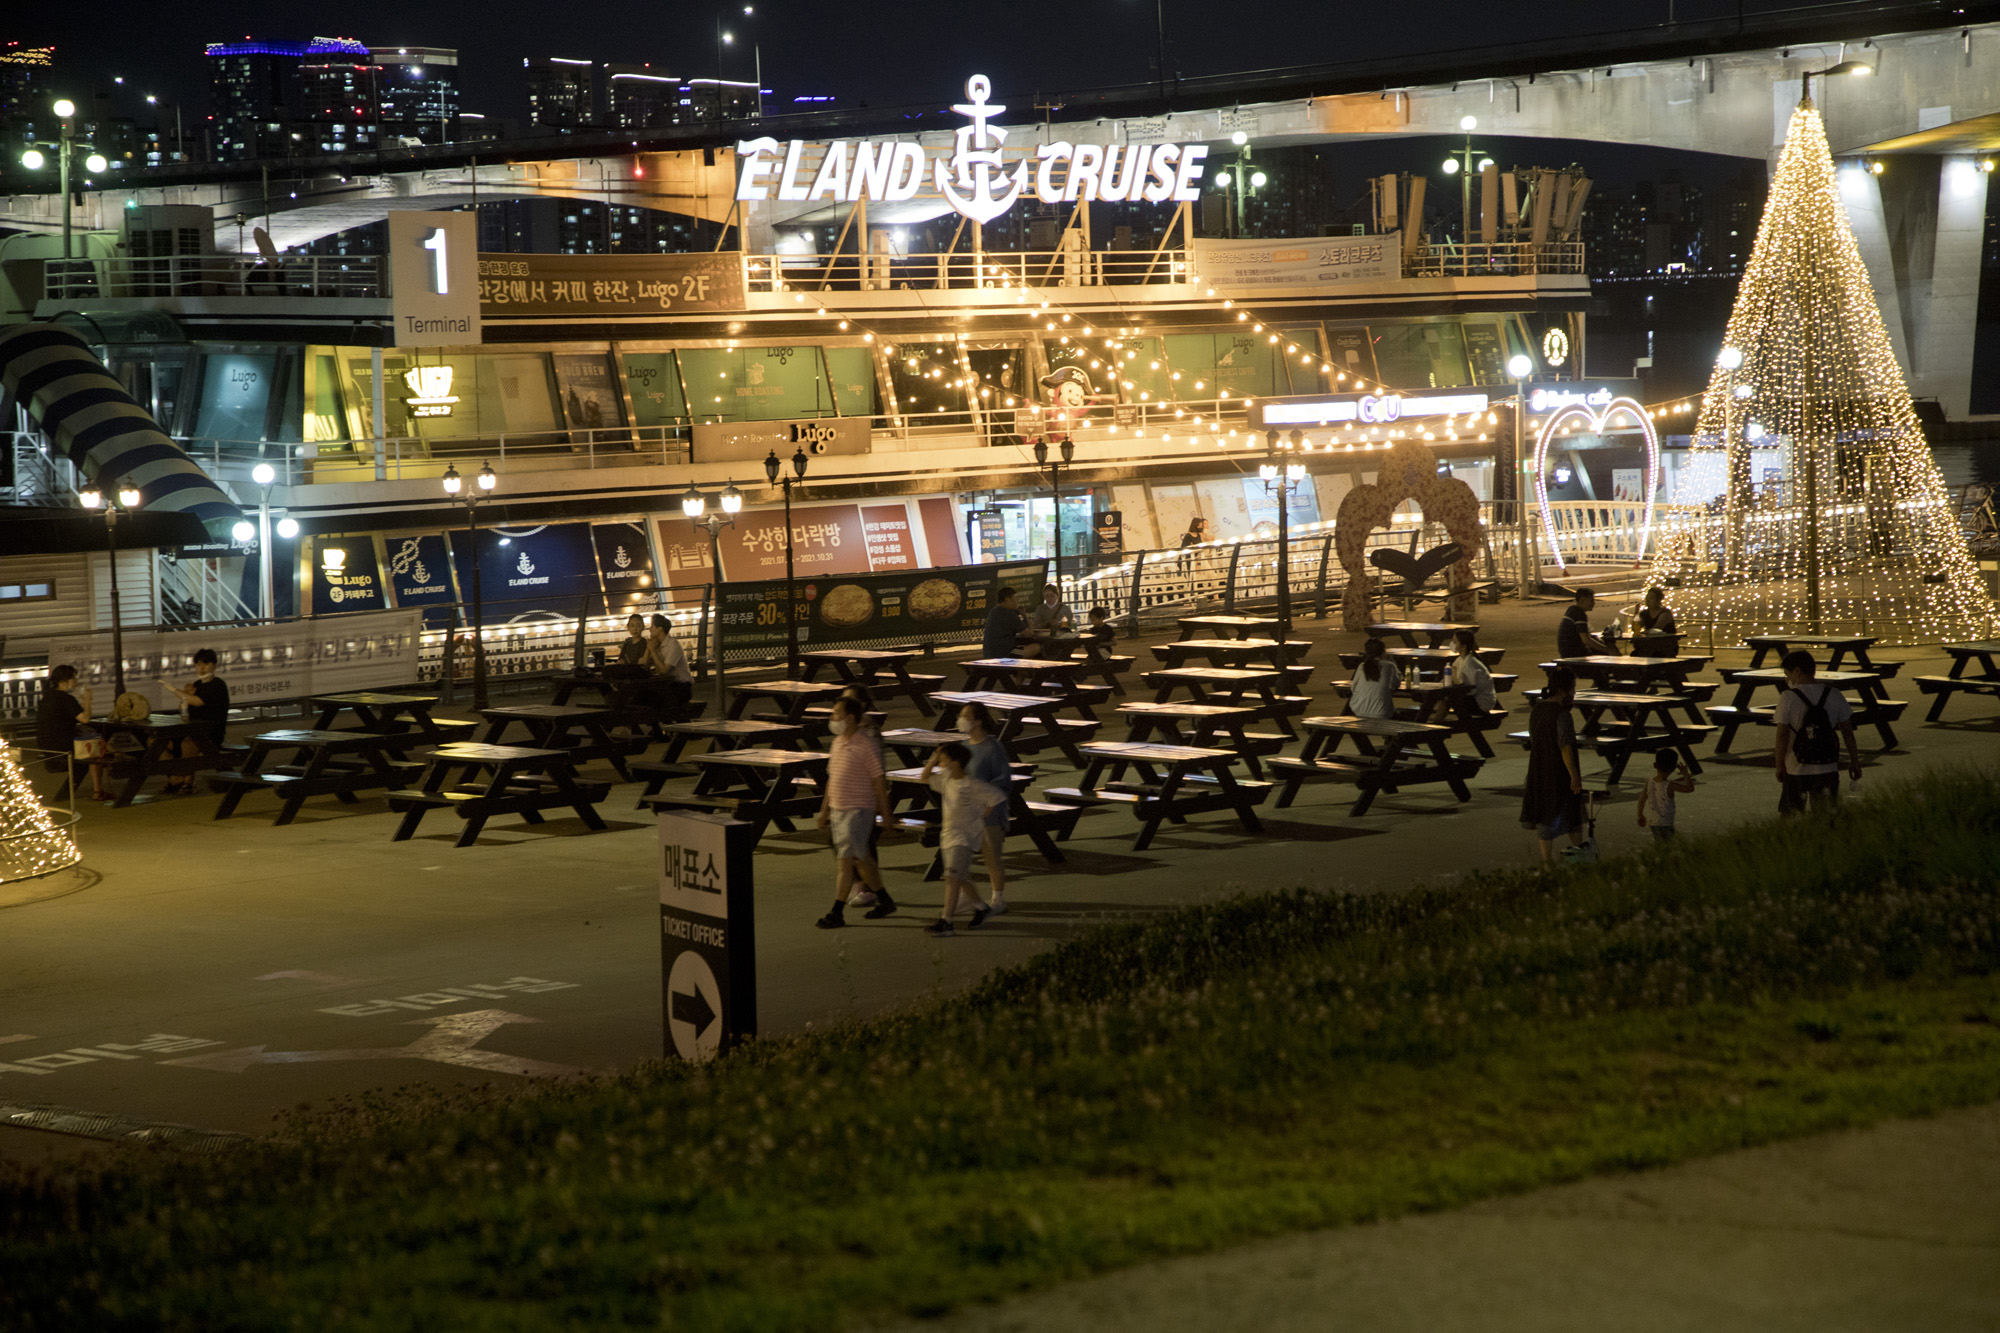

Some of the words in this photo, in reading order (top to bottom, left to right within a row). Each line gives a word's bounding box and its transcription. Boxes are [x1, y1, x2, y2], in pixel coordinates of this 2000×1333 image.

[1035, 143, 1209, 203] CRUISE
[424, 228, 448, 294] 1
[1318, 244, 1383, 267] 스토리크루즈
[552, 280, 589, 303] 커피
[637, 279, 679, 308] Lugo
[682, 275, 711, 302] 2F
[406, 315, 471, 333] Terminal
[1232, 336, 1254, 355] Lugo
[766, 346, 794, 365] Lugo
[231, 369, 257, 391] Lugo
[582, 365, 605, 376] BREW
[628, 366, 657, 387] Lugo
[646, 391, 665, 404] Lugo
[795, 423, 837, 455] Lugo
[792, 522, 841, 547] 다락방
[230, 539, 259, 555] Lugo
[800, 552, 834, 563] 2021.10.31
[344, 575, 373, 586] Lugo
[529, 576, 550, 585] CRUISE
[626, 570, 645, 578] CRUISE
[344, 589, 375, 599] 카페루고
[424, 585, 446, 594] CRUISE
[721, 613, 738, 625] 포장
[738, 612, 755, 624] 주문
[757, 602, 787, 626] 30%
[664, 844, 722, 895] 매표소
[662, 915, 692, 940] TICKET
[692, 922, 725, 948] OFFICE
